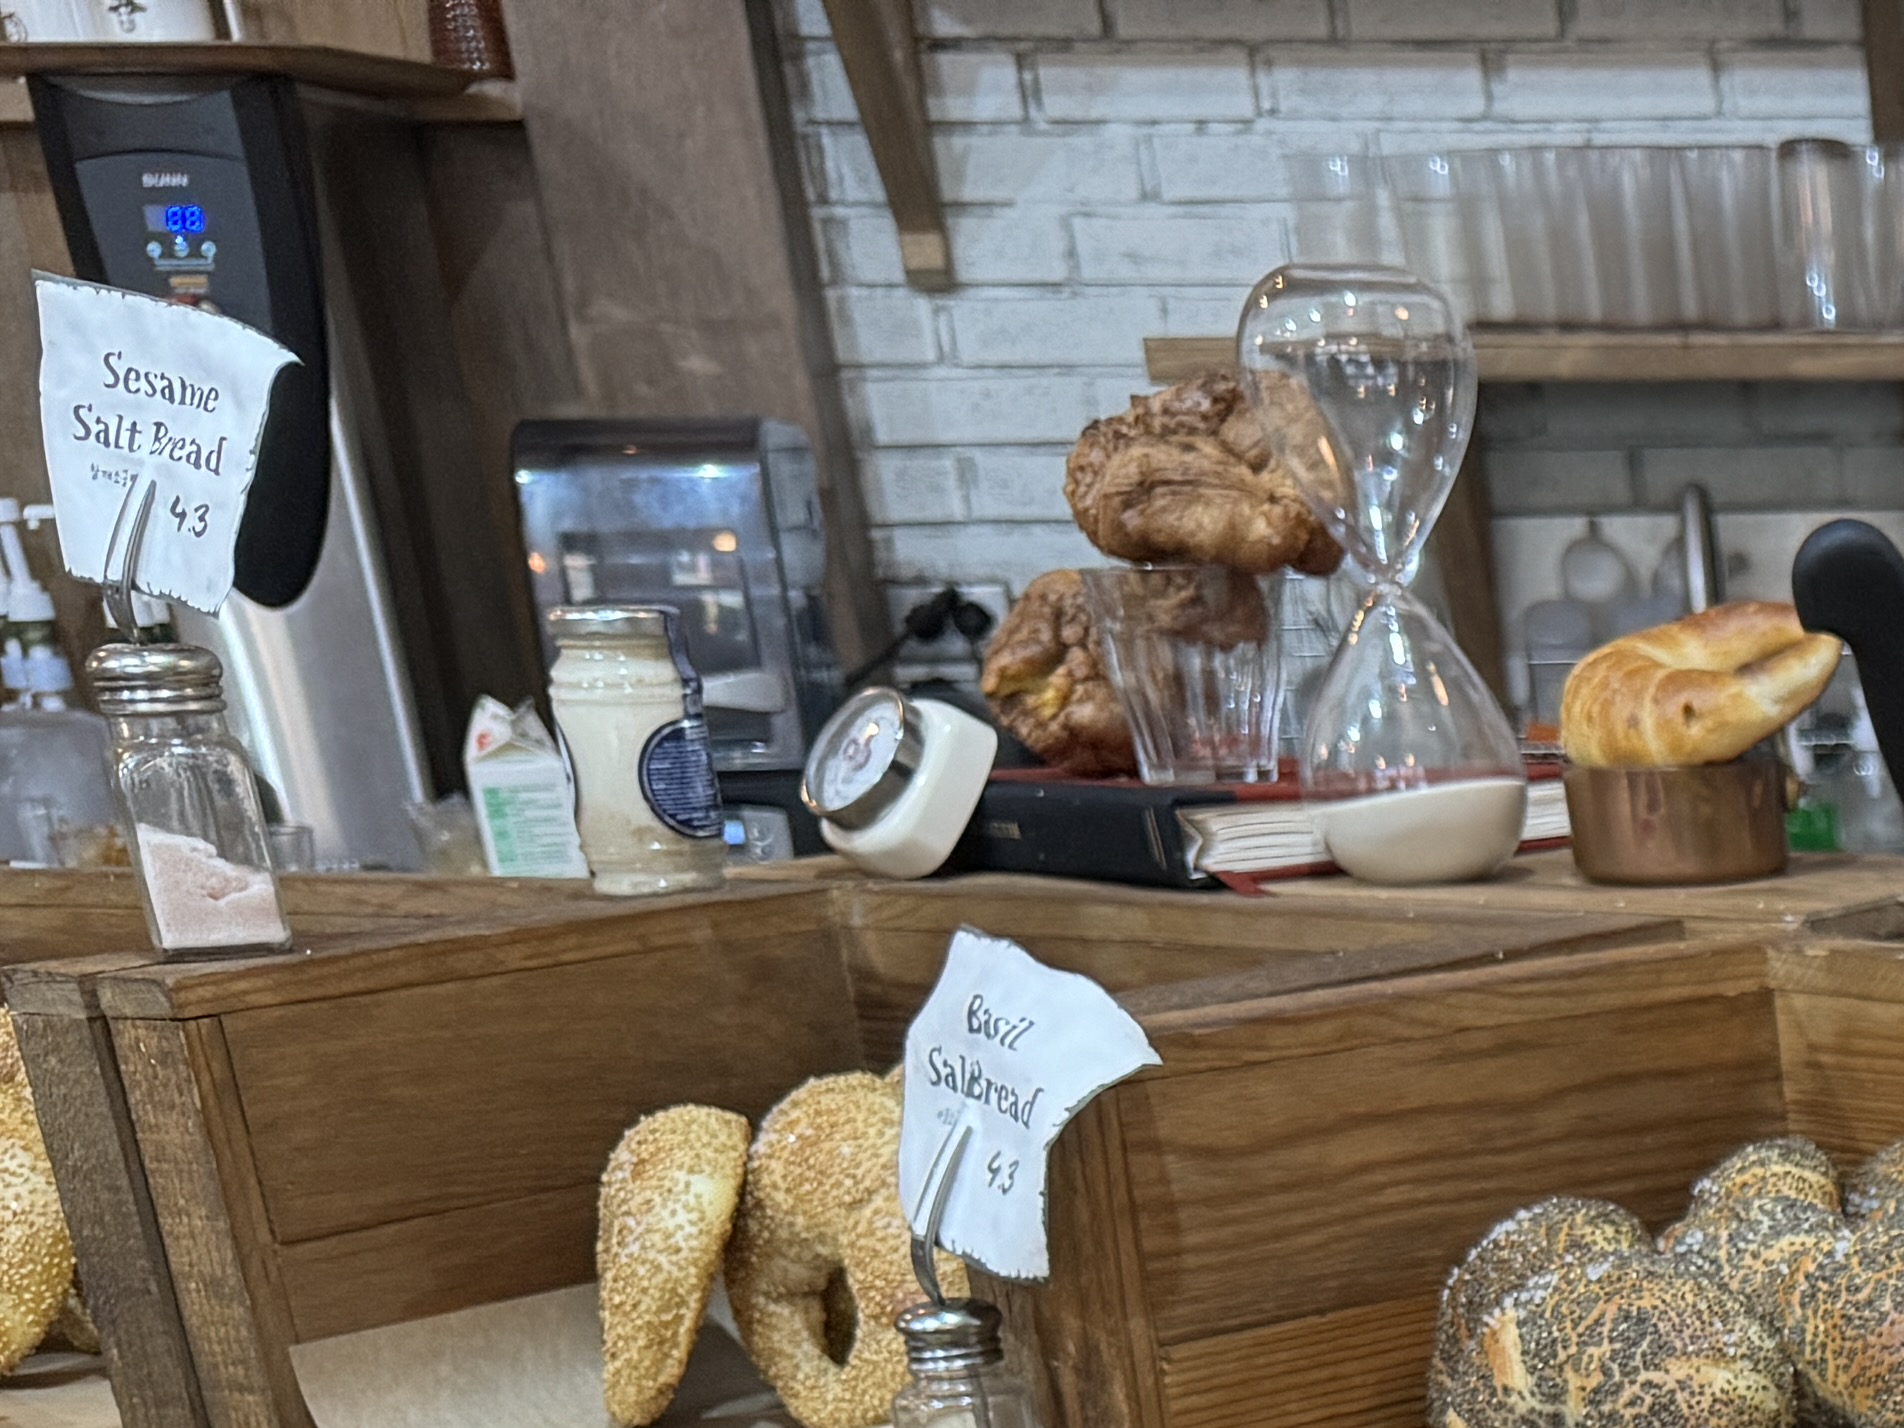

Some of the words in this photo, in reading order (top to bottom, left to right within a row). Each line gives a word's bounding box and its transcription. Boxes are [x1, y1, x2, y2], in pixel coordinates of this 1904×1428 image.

[103, 350, 219, 413] Sesame
[72, 403, 142, 453] Salt
[149, 421, 228, 476] Bread
[170, 495, 209, 538] 4.3
[967, 993, 1036, 1052] Basil
